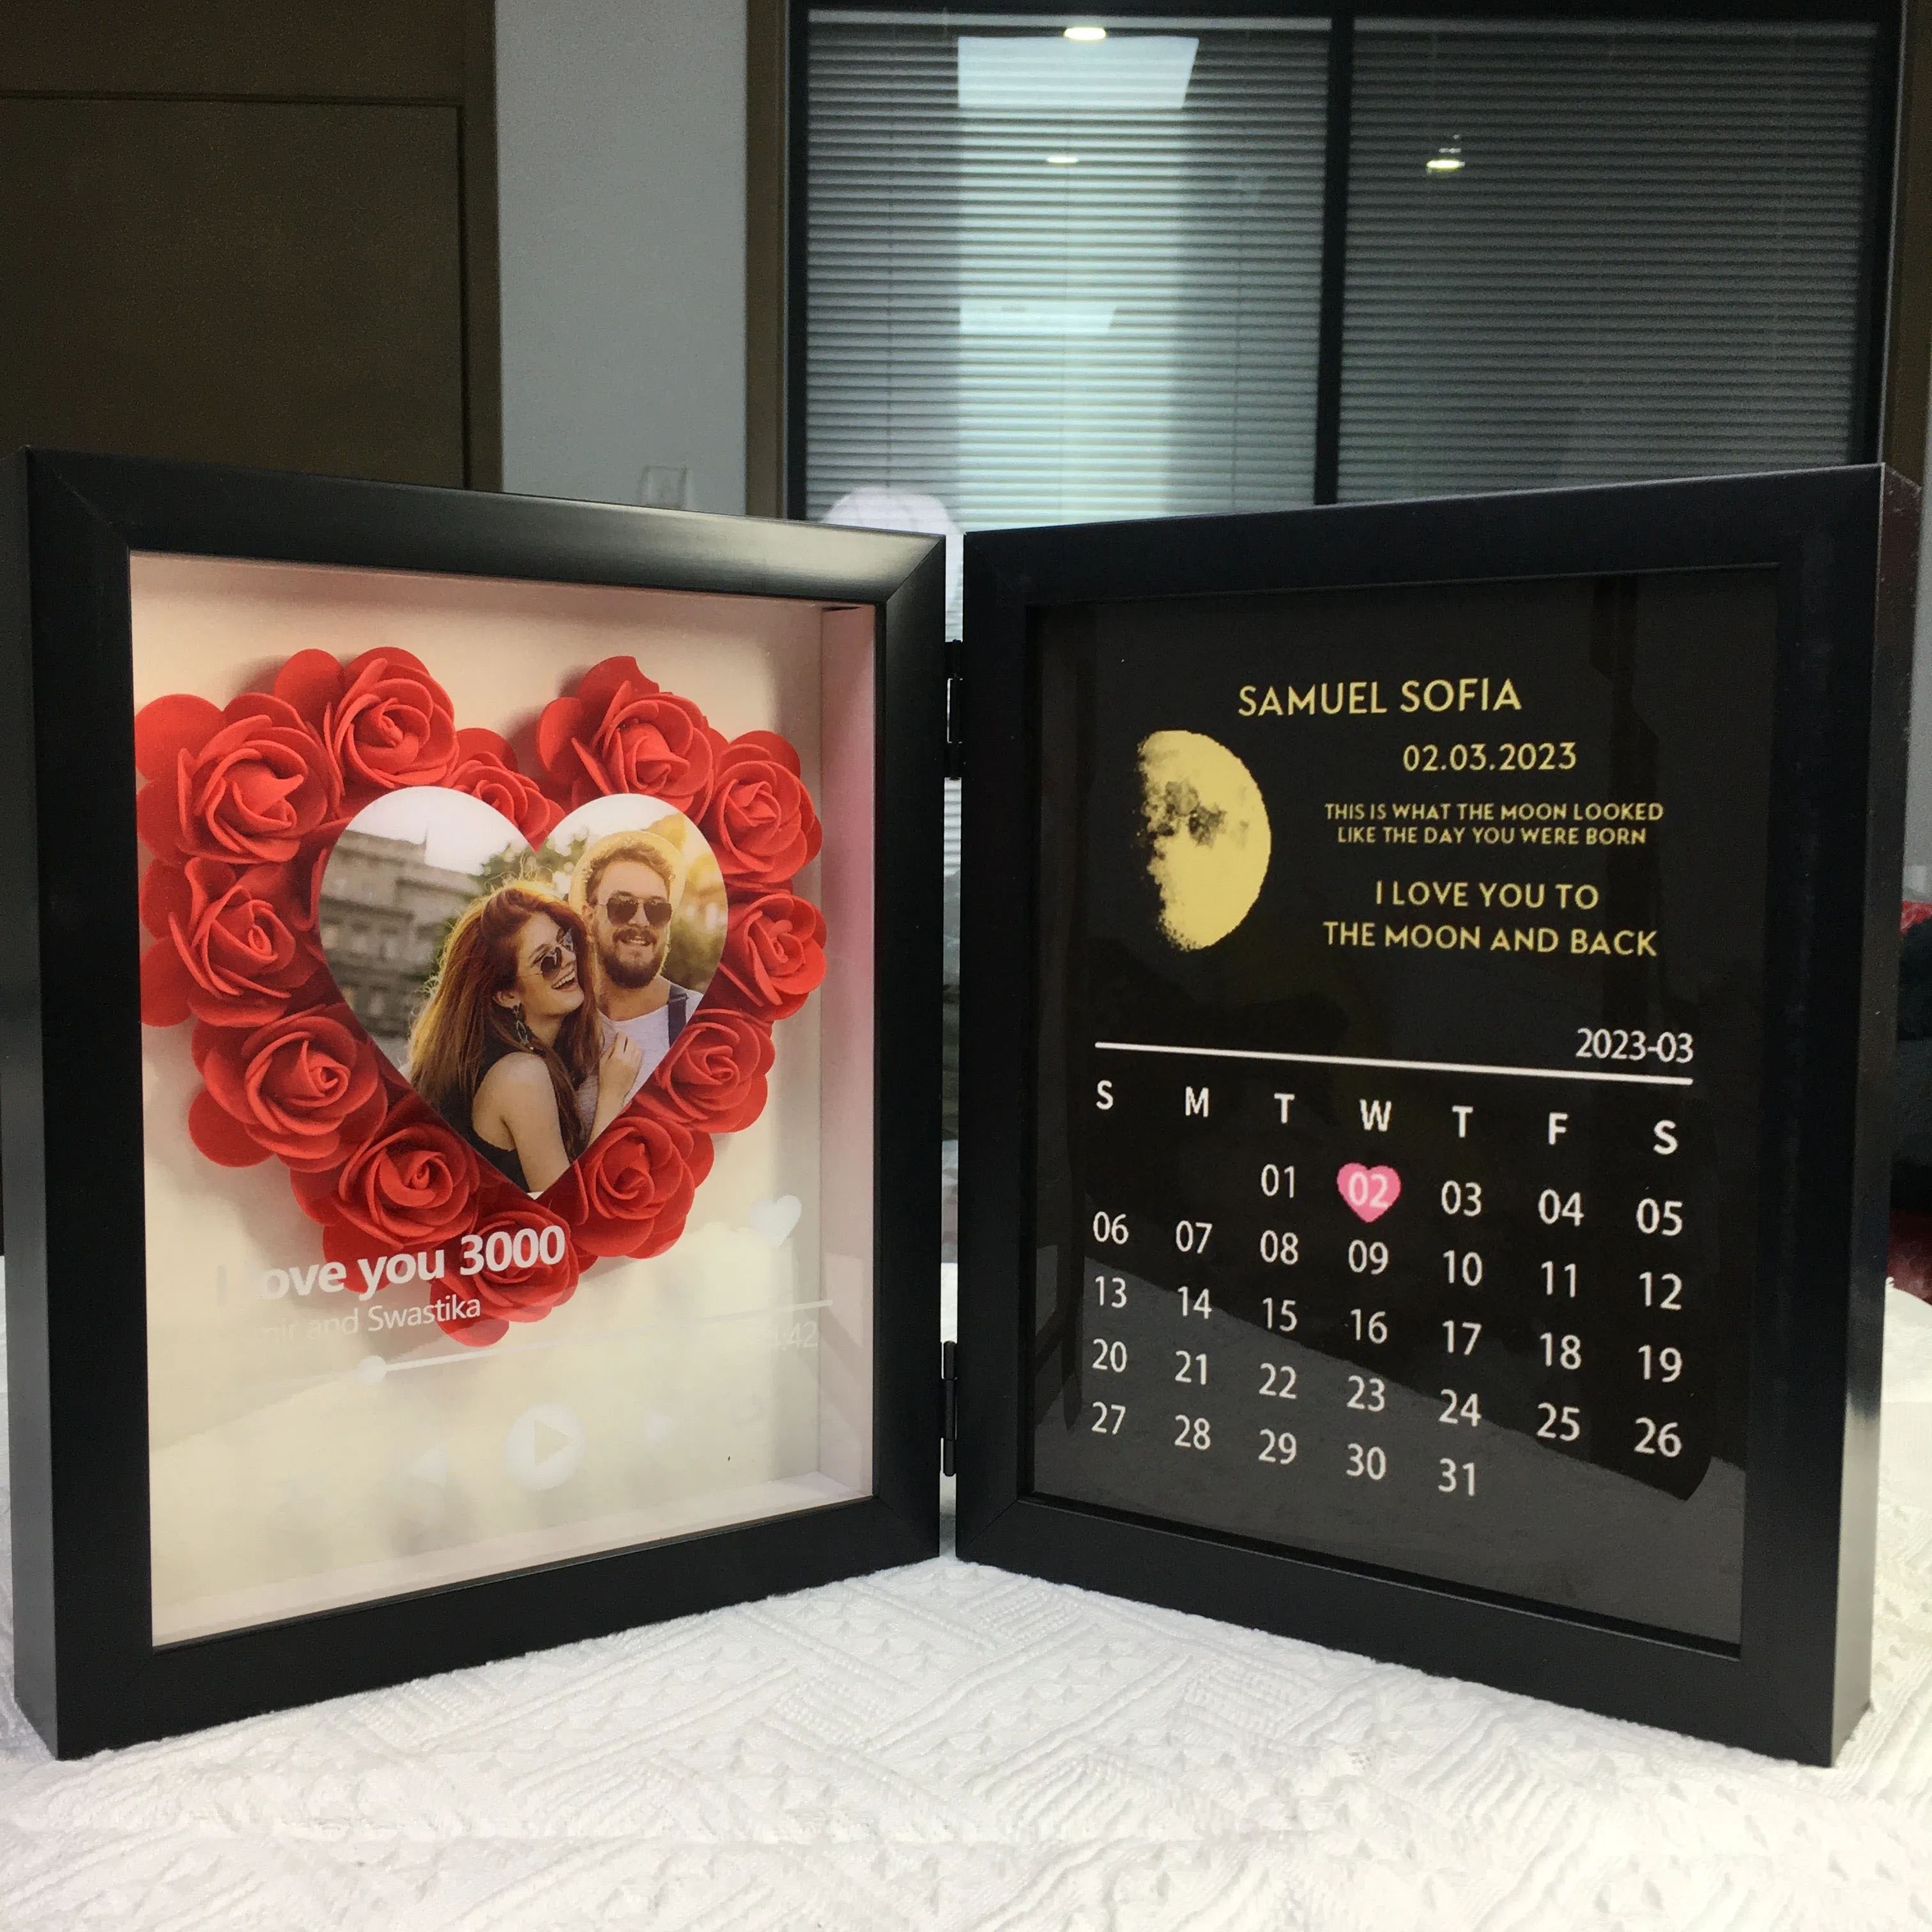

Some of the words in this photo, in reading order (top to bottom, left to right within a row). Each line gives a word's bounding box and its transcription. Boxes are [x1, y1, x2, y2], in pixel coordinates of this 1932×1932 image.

[1238, 681, 1388, 717] SAMUEL
[1400, 677, 1522, 713] SOFIA
[1402, 742, 1577, 772] 02.03.2023
[1324, 803, 1365, 820] THIS
[1370, 803, 1386, 820] IS
[1392, 802, 1452, 820] WHAT
[1457, 802, 1494, 820] THE
[1500, 802, 1567, 821] MOON
[1573, 802, 1664, 821] LOOKED
[1338, 826, 1376, 843] LIKE
[1383, 826, 1418, 844] THE
[1424, 826, 1466, 844] DAY
[1472, 827, 1515, 845] YOU
[1521, 827, 1579, 845] WERE
[1586, 827, 1646, 845] BORN
[1376, 880, 1383, 905] I
[1392, 880, 1468, 907] LOVE
[1478, 882, 1545, 908] YOU
[1555, 884, 1599, 910] TO
[1323, 921, 1376, 947] THE
[1384, 924, 1481, 950] MOON
[1490, 927, 1559, 953] AND
[1570, 928, 1657, 957] BACK
[1575, 1027, 1694, 1064] 2023-03
[1095, 1079, 1114, 1110] S
[1184, 1085, 1209, 1118] M
[1273, 1092, 1296, 1124] T
[1359, 1098, 1392, 1132] W
[1452, 1105, 1474, 1138] T
[1548, 1112, 1568, 1146] F
[1653, 1119, 1678, 1155] S
[1261, 1163, 1295, 1199] 01
[1348, 1171, 1389, 1209] 02
[1441, 1179, 1482, 1217] 03
[1537, 1188, 1585, 1227] 04
[1636, 1197, 1683, 1237] 05
[246, 1260, 346, 1299] ove
[358, 1250, 444, 1300] you
[461, 1226, 565, 1275] 3000
[1092, 1210, 1130, 1245] 06
[1175, 1220, 1213, 1254] 07
[1259, 1229, 1299, 1266] 08
[1347, 1239, 1389, 1275] 09
[1443, 1250, 1483, 1287] 10
[1540, 1260, 1576, 1298] 11
[1639, 1271, 1682, 1311] 12
[306, 1307, 359, 1340] and
[368, 1294, 480, 1331] Swastika
[1094, 1275, 1128, 1309] 13
[1177, 1285, 1213, 1320] 14
[1262, 1297, 1298, 1332] 15
[1351, 1308, 1388, 1344] 16
[1442, 1319, 1482, 1356] 17
[1540, 1332, 1582, 1370] 18
[1637, 1344, 1683, 1383] 19
[1091, 1338, 1128, 1374] 20
[1174, 1349, 1208, 1386] 21
[1258, 1362, 1298, 1400] 22
[1346, 1374, 1386, 1413] 23
[1438, 1388, 1482, 1427] 24
[1537, 1402, 1581, 1442] 25
[1634, 1416, 1682, 1458] 26
[1091, 1400, 1126, 1436] 27
[1174, 1414, 1211, 1451] 28
[1257, 1428, 1298, 1465] 29
[1346, 1442, 1387, 1481] 30
[1438, 1457, 1476, 1497] 31
